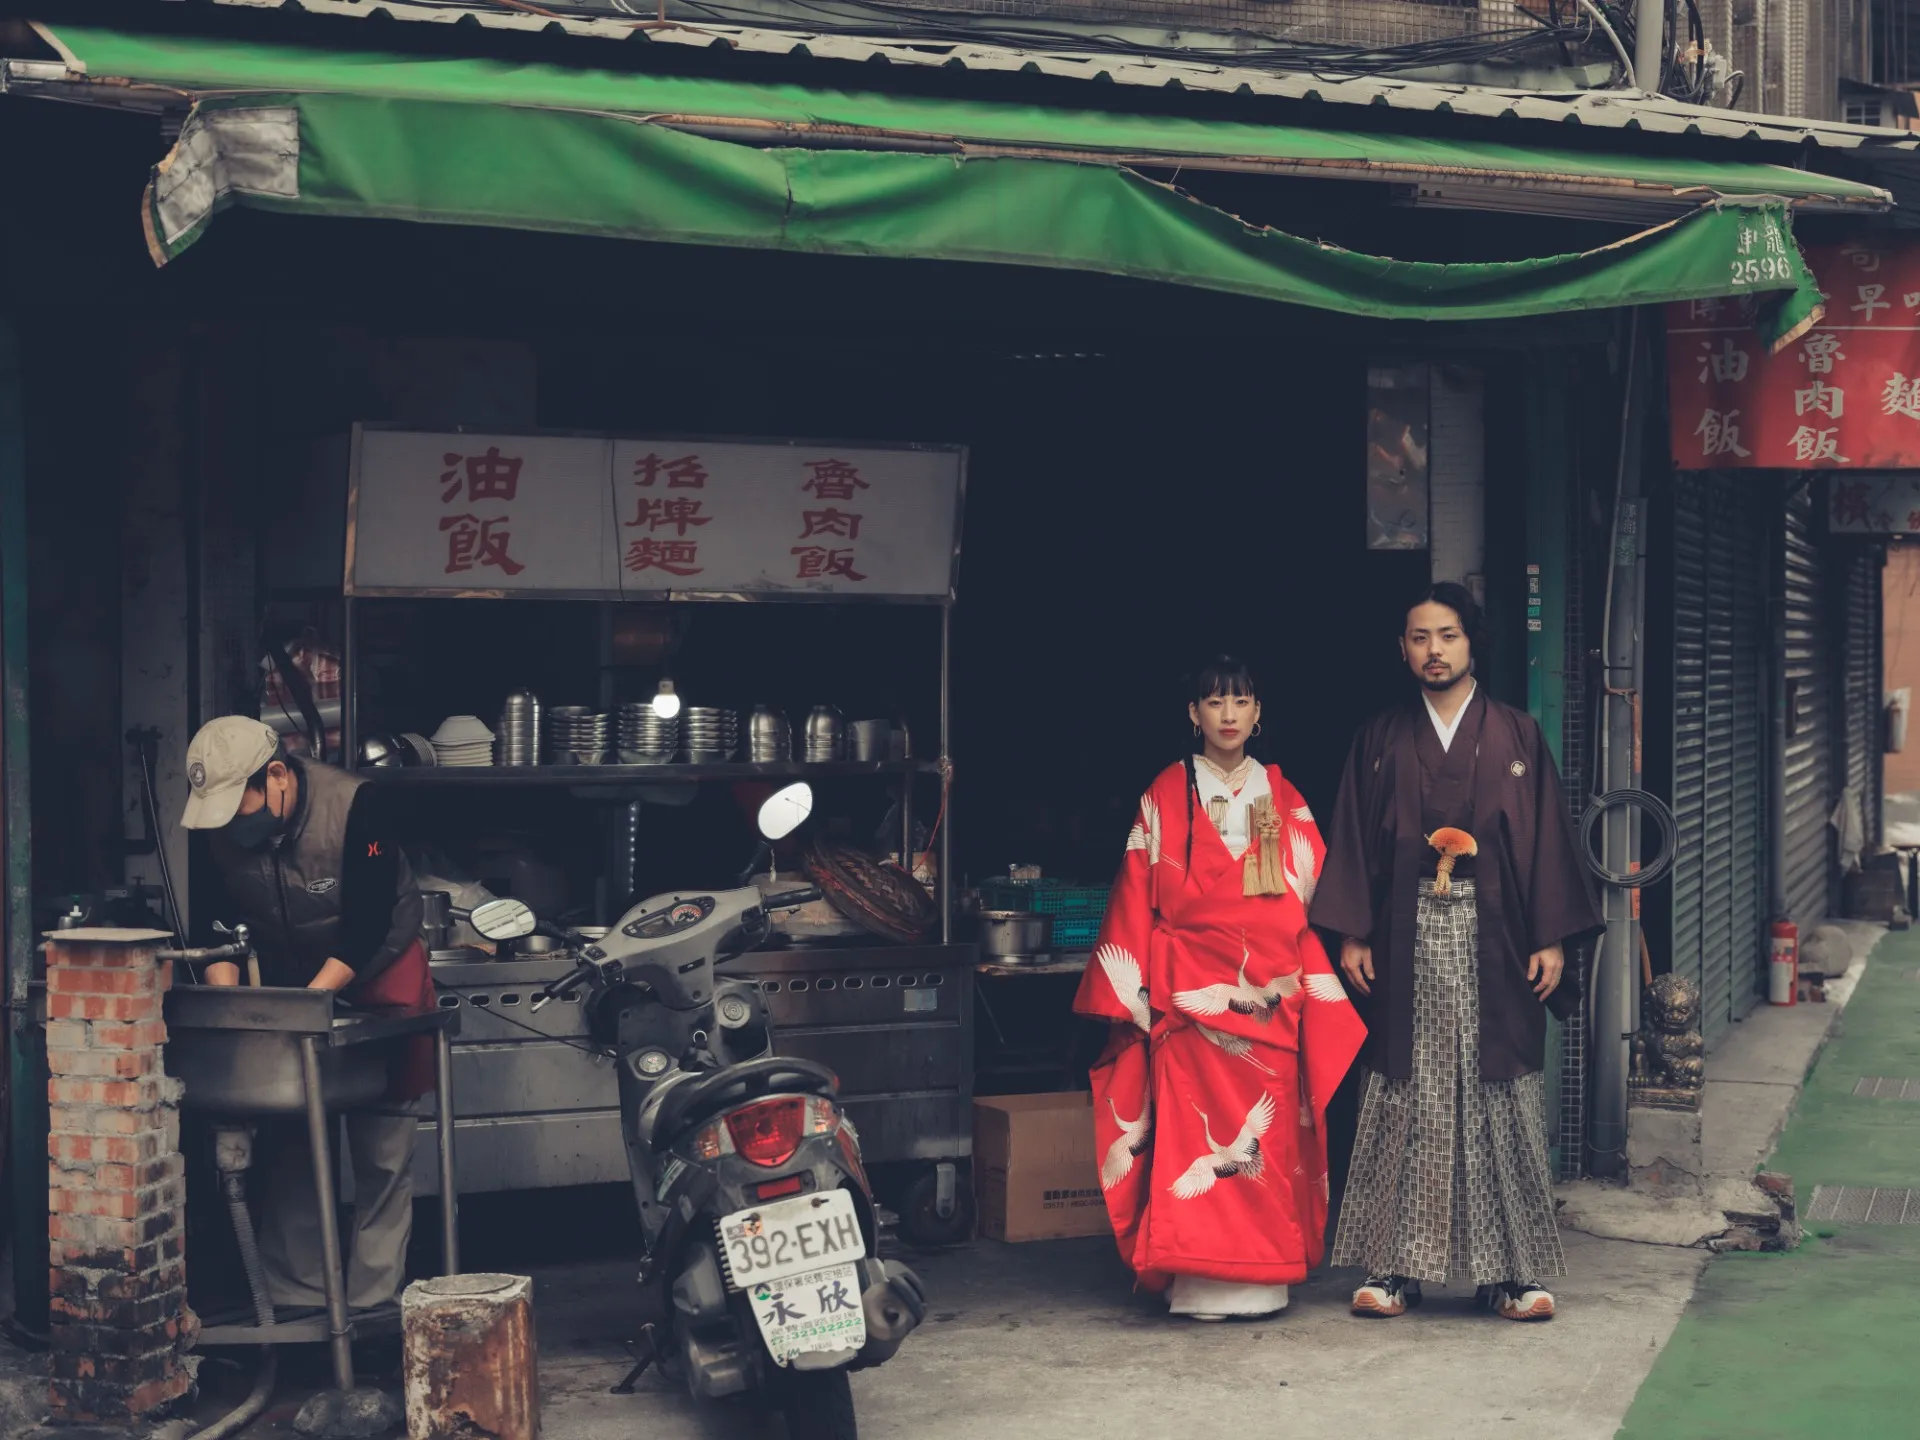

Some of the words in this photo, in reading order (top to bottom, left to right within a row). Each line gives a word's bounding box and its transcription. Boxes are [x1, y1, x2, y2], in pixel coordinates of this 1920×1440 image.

[1731, 257, 1793, 285] 2596
[1693, 339, 1751, 458] 油飯
[1787, 333, 1850, 462] 魯肉飯
[438, 446, 525, 576] 油飯
[625, 451, 713, 577] 招牌麵
[791, 456, 871, 582] 魯肉飯
